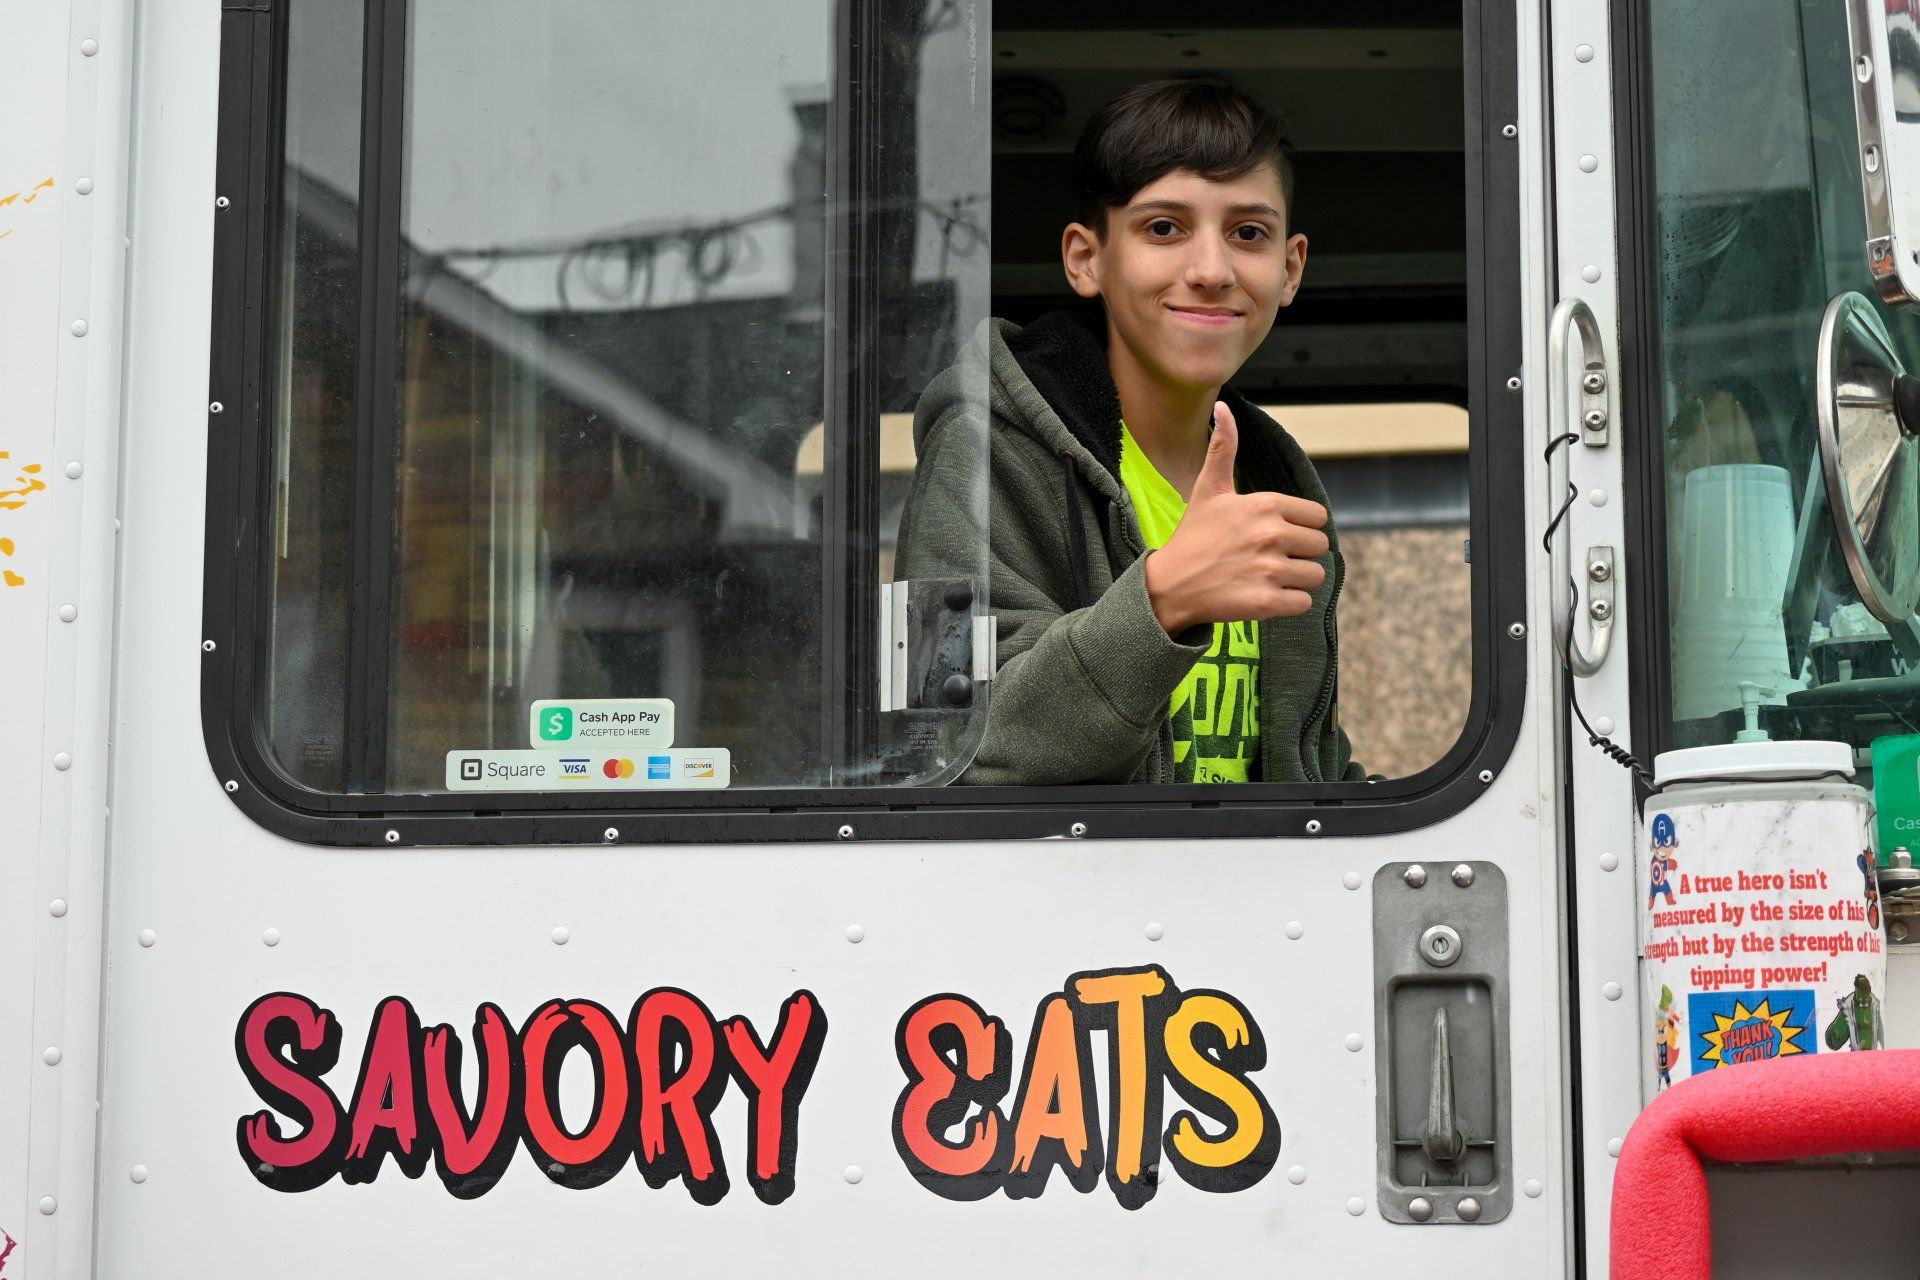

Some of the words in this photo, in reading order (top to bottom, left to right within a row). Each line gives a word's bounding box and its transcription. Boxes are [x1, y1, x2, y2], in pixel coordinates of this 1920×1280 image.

[579, 711, 609, 723] Cash
[611, 712, 636, 725] App
[639, 711, 661, 725] Pay
[579, 728, 625, 737] ACCEPTED
[627, 728, 650, 737] HERE
[487, 761, 546, 779] Square
[563, 764, 587, 774] VISA
[1679, 873, 1691, 895] A
[1695, 874, 1733, 893] true
[1738, 870, 1784, 892] hero
[1789, 868, 1828, 890] isn't
[1653, 902, 1717, 928] measured
[1721, 902, 1745, 927] by
[1750, 900, 1784, 922] the
[1789, 899, 1824, 921] size
[1828, 900, 1844, 921] of
[1847, 900, 1865, 921] his
[1683, 933, 1709, 954] but
[1713, 933, 1736, 958] by
[1741, 932, 1775, 953] the
[1779, 932, 1854, 957] strength
[1857, 931, 1868, 952] of
[1690, 964, 1755, 990] tipping
[1761, 961, 1828, 989] power!
[1720, 1019, 1774, 1051] THANK
[238, 988, 820, 1195] SAVORY
[895, 966, 1275, 1200] EATS
